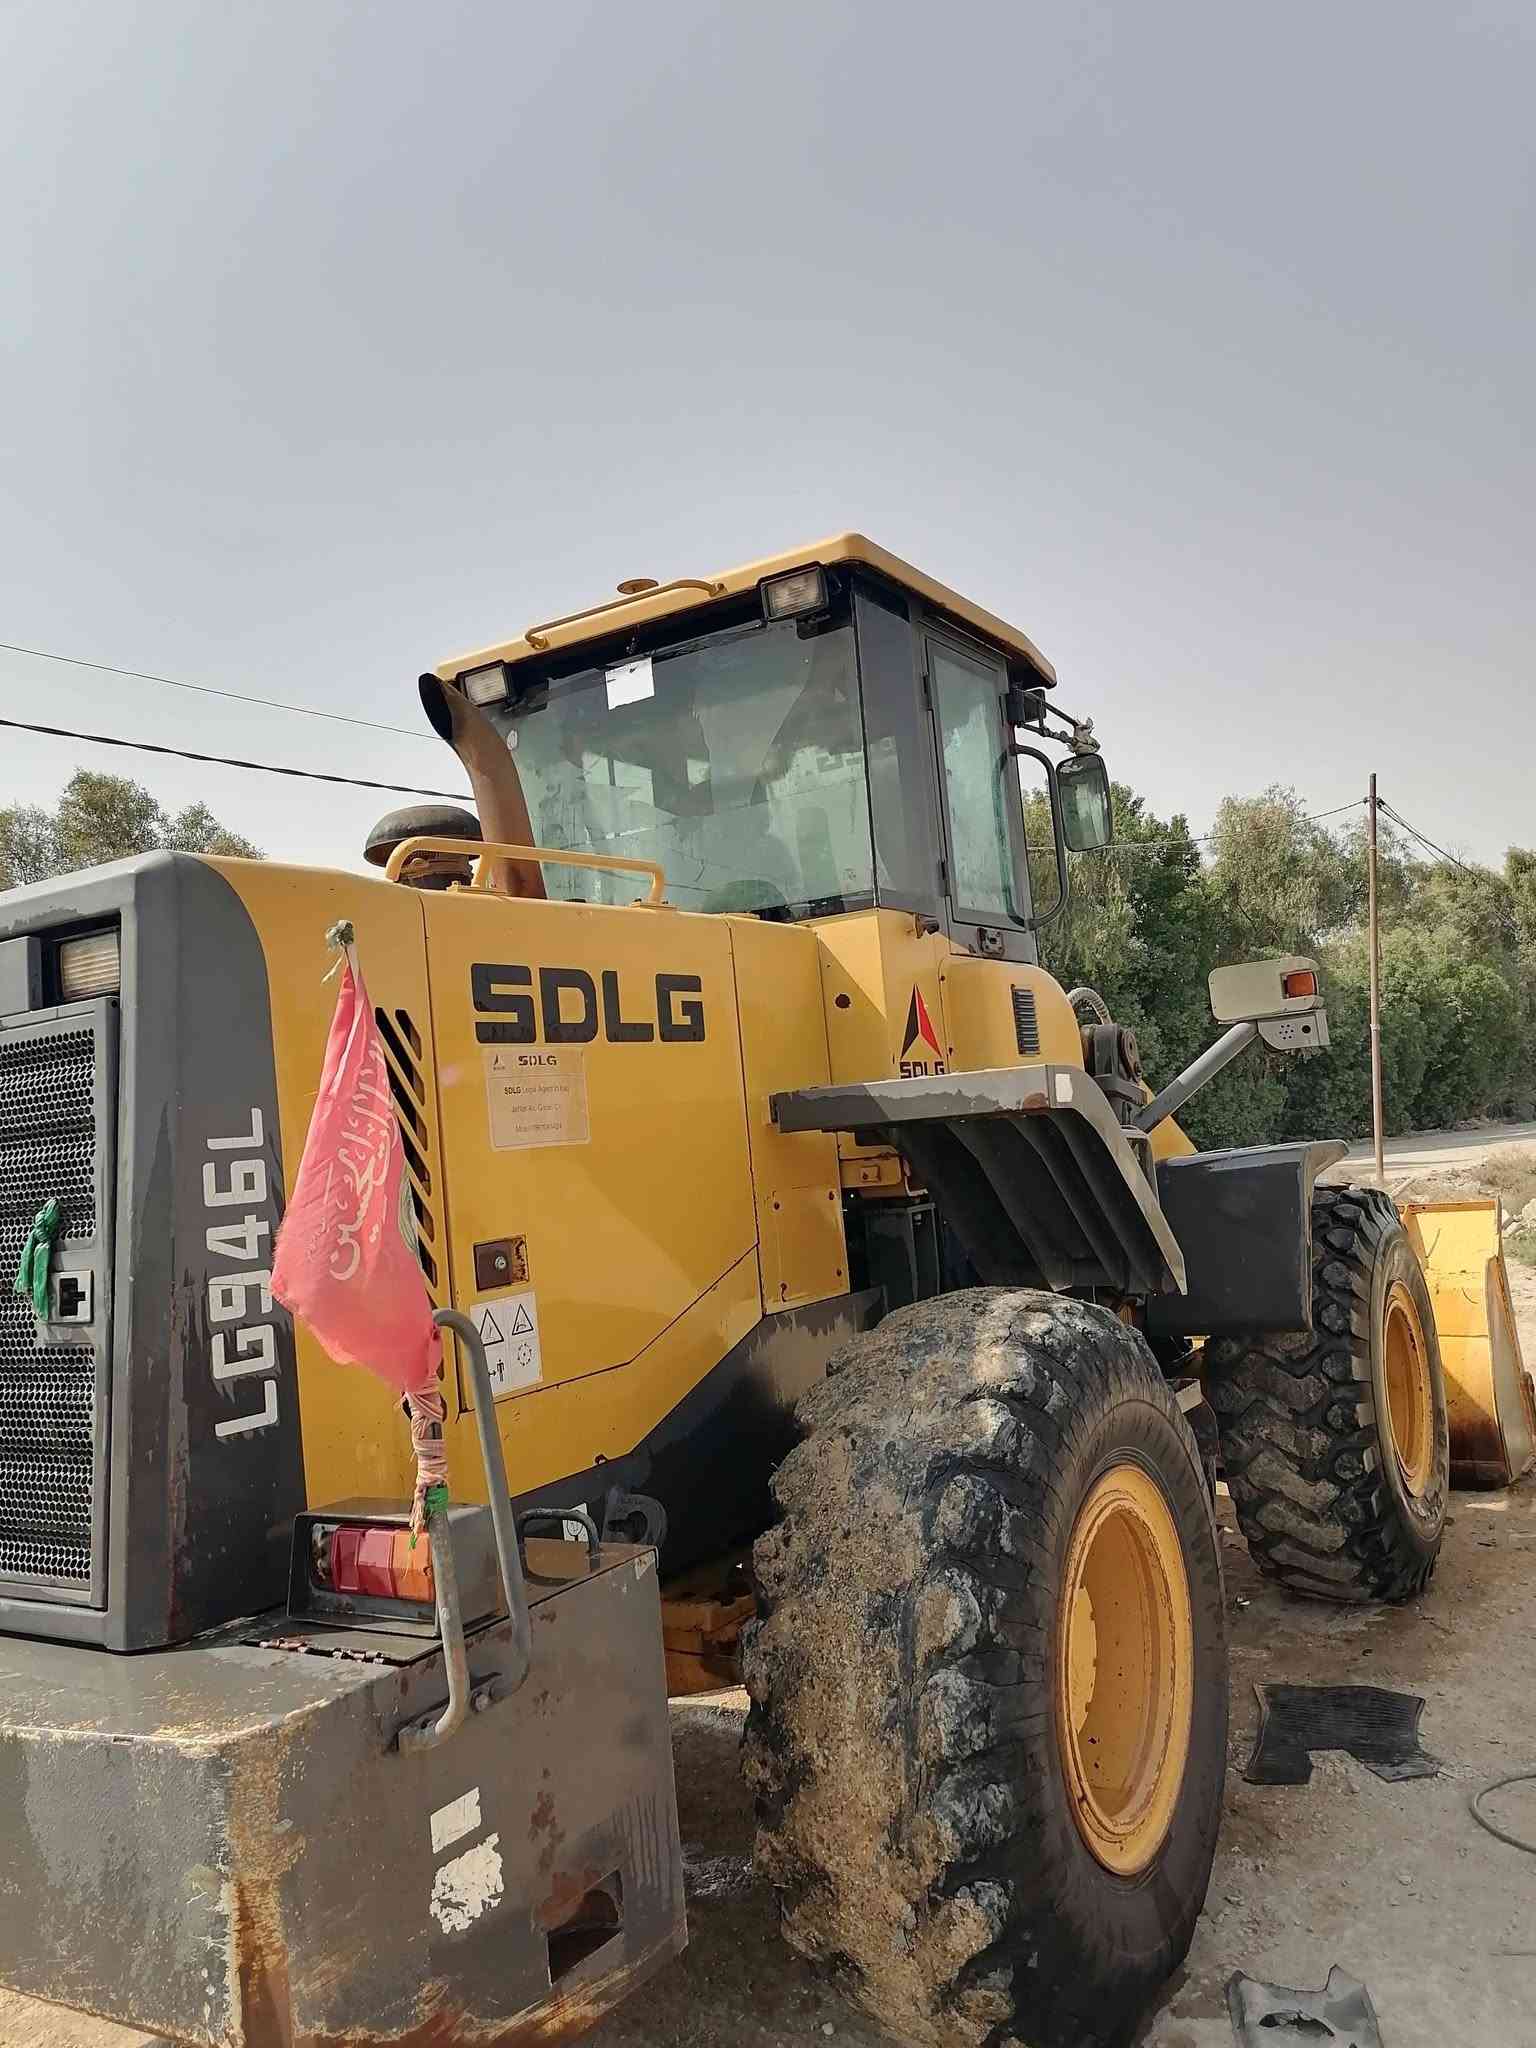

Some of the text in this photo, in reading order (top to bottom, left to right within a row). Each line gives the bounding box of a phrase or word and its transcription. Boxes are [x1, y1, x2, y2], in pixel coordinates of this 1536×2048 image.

[471, 963, 705, 1043] SDLG
[518, 1054, 557, 1067] SDLG
[899, 1061, 945, 1079] SDLG
[202, 1107, 278, 1438] LG946L
